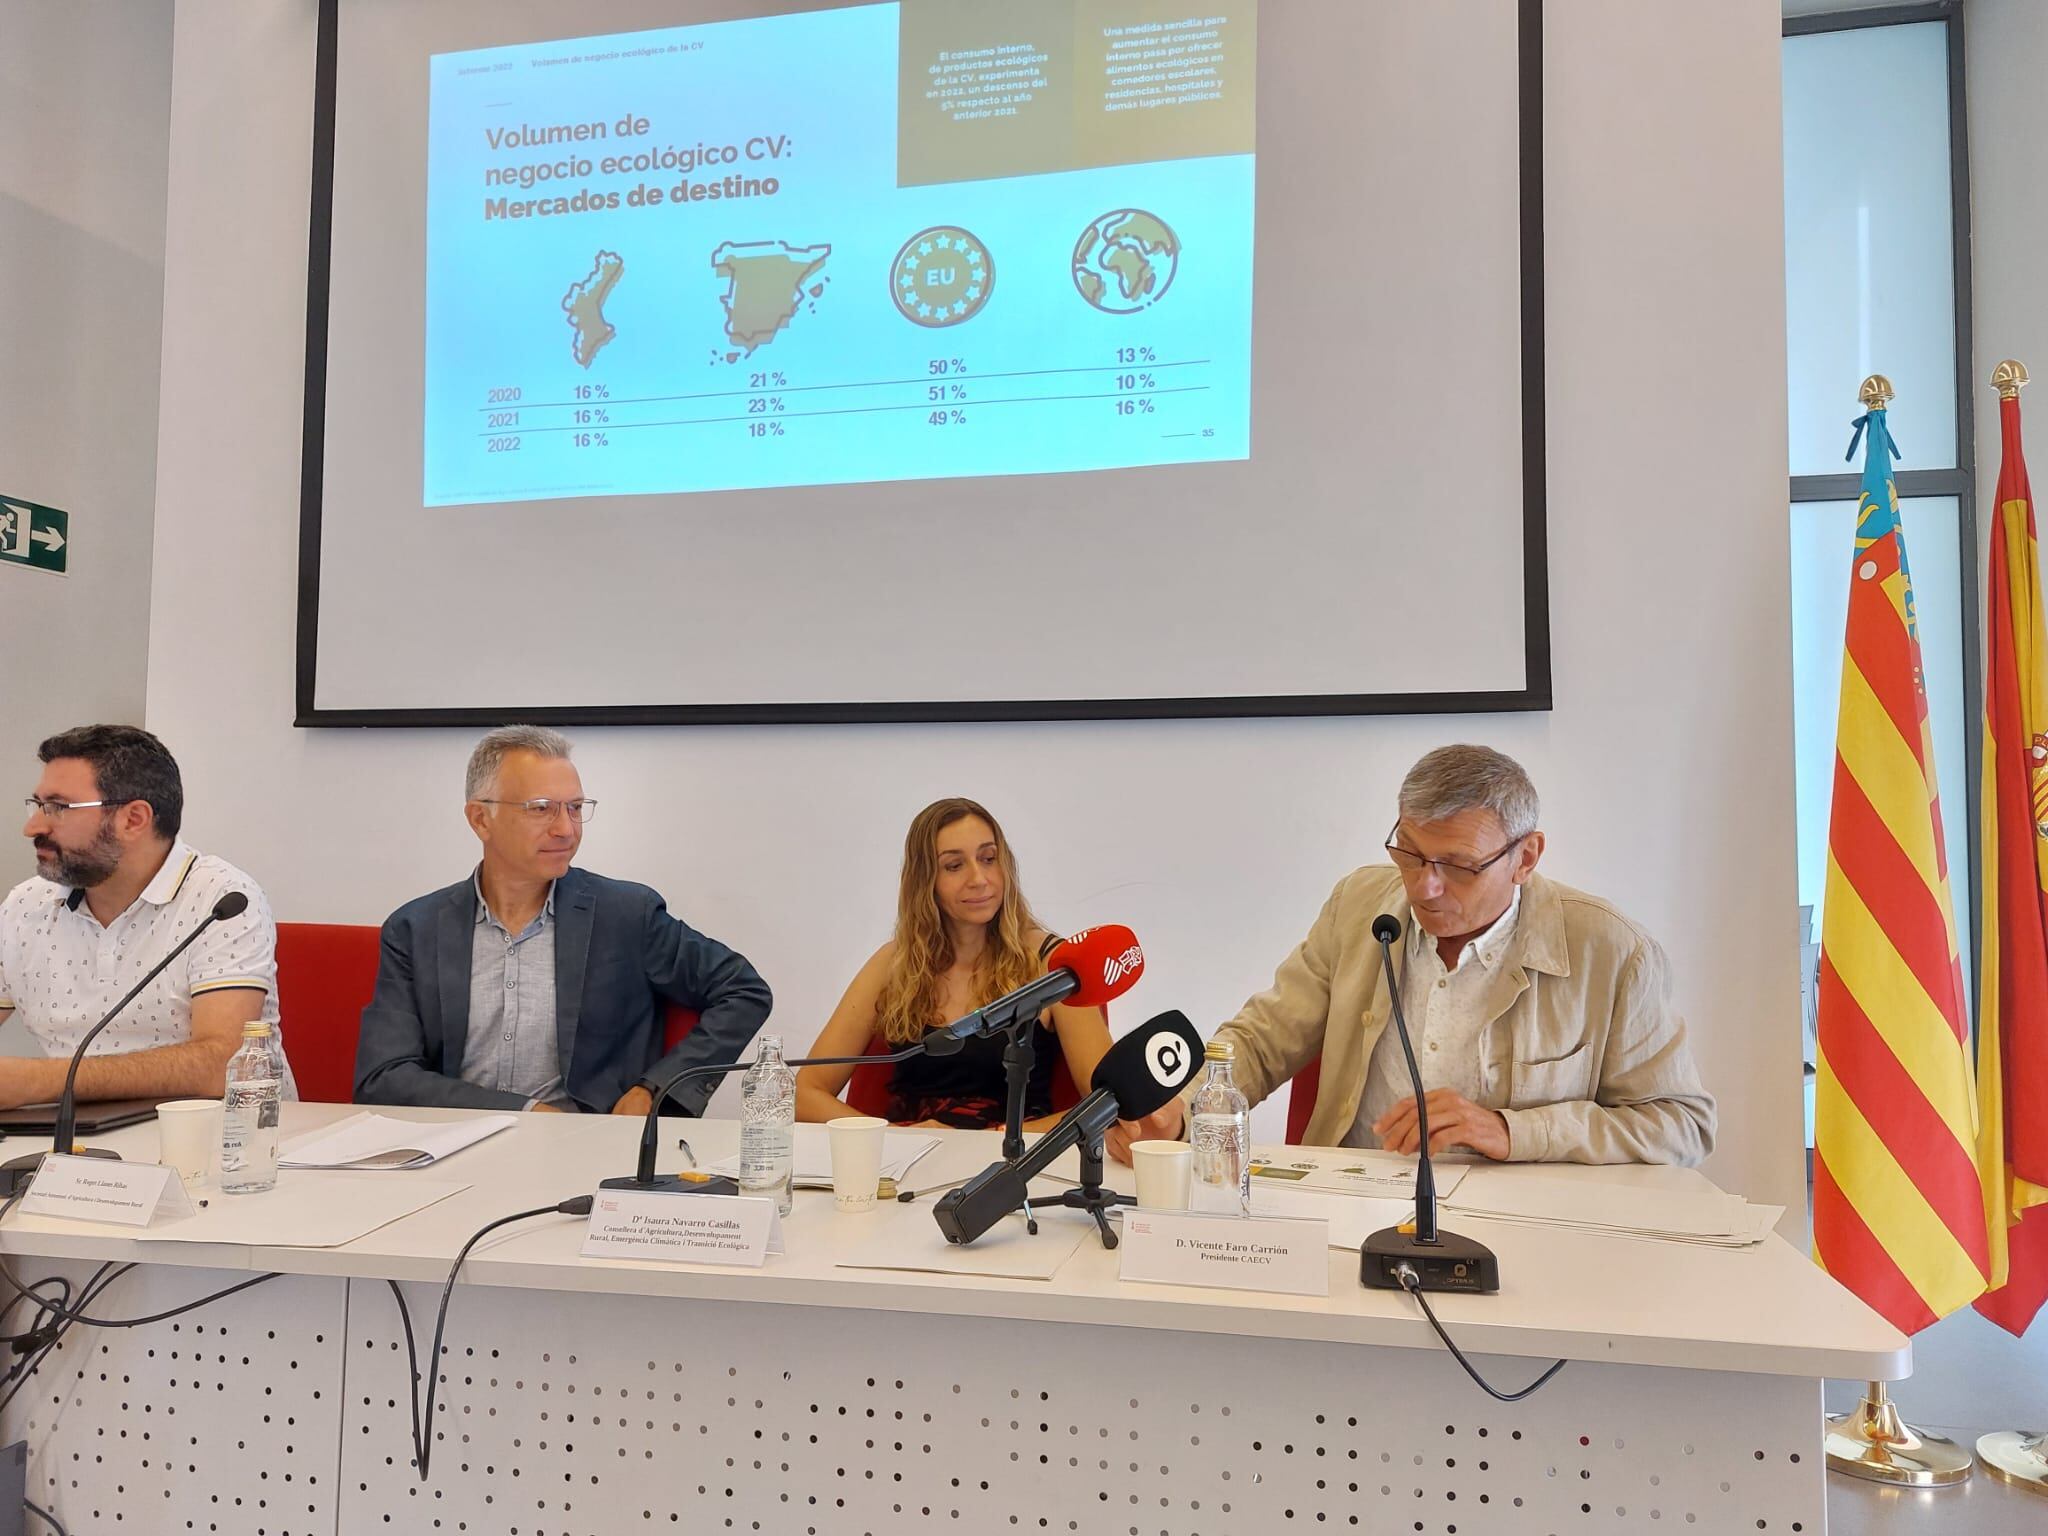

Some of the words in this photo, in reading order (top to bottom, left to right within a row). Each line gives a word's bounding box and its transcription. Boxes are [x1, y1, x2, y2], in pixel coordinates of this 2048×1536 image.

[1103, 28, 1123, 37] Una
[1125, 23, 1162, 35] medida
[1164, 18, 1202, 30] sencilla
[1204, 16, 1227, 27] para
[1112, 36, 1160, 49] aumentar
[1161, 34, 1171, 44] el
[1172, 30, 1218, 42] consumo
[571, 54, 583, 64] de
[584, 50, 620, 64] negocio
[622, 46, 666, 60] ecológico
[667, 44, 679, 54] de
[680, 42, 690, 52] la
[691, 41, 705, 51] CV
[940, 52, 950, 61] El
[951, 48, 996, 60] consumo
[1105, 50, 1142, 62] interno
[1143, 48, 1167, 59] pasa
[1168, 46, 1186, 56] por
[1187, 41, 1224, 52] ofrecer
[928, 64, 942, 74] de
[943, 59, 993, 74] productos
[995, 54, 1048, 66] ecológicos
[1105, 62, 1154, 74] alimentos
[1155, 56, 1209, 68] ecológicos
[1211, 54, 1224, 62] en
[934, 76, 947, 86] de
[948, 75, 958, 84] la
[978, 67, 1040, 81] experimenta
[1112, 73, 1166, 86] comedores
[926, 89, 939, 98] en
[968, 85, 981, 94] un
[983, 80, 1030, 93] descenso
[1032, 77, 1048, 88] del
[1164, 80, 1216, 92] hospitales
[1216, 80, 1224, 88] y
[957, 96, 1000, 108] respecto
[1002, 94, 1012, 104] al
[1014, 92, 1033, 102] año
[1104, 100, 1138, 112] demás
[1139, 96, 1177, 108] lugares
[952, 108, 993, 120] anterior
[486, 122, 607, 151] Volumen
[614, 114, 650, 138] de
[484, 155, 593, 190] negocio
[601, 144, 738, 176] ecológico
[744, 134, 792, 161] CV:
[484, 186, 620, 221] Mercados
[626, 183, 664, 208] de
[670, 174, 780, 205] destino
[926, 266, 956, 286] EU
[1116, 348, 1135, 363] 13
[928, 360, 948, 376] 50
[750, 372, 768, 388] 21
[1116, 374, 1135, 390] 10
[487, 387, 522, 404] 2020
[574, 385, 591, 400] 16
[928, 386, 947, 401] 51
[748, 398, 766, 414] 23
[1115, 400, 1135, 416] 16
[487, 412, 520, 428] 2021
[573, 410, 591, 424] 16
[928, 410, 948, 426] 49
[748, 422, 766, 438] 18
[487, 437, 521, 454] 2022
[573, 434, 590, 448] 16
[603, 1225, 637, 1234] Consellera
[644, 1216, 670, 1226] Isaura
[672, 1218, 706, 1228] Navarro
[708, 1219, 740, 1230] Casillas
[1176, 1238, 1187, 1248] D.
[1189, 1240, 1224, 1250] Vicente
[1226, 1242, 1248, 1252] Faro
[1250, 1244, 1288, 1255] Carrión
[1200, 1252, 1240, 1262] Presidente
[1240, 1255, 1272, 1264] CAECV
